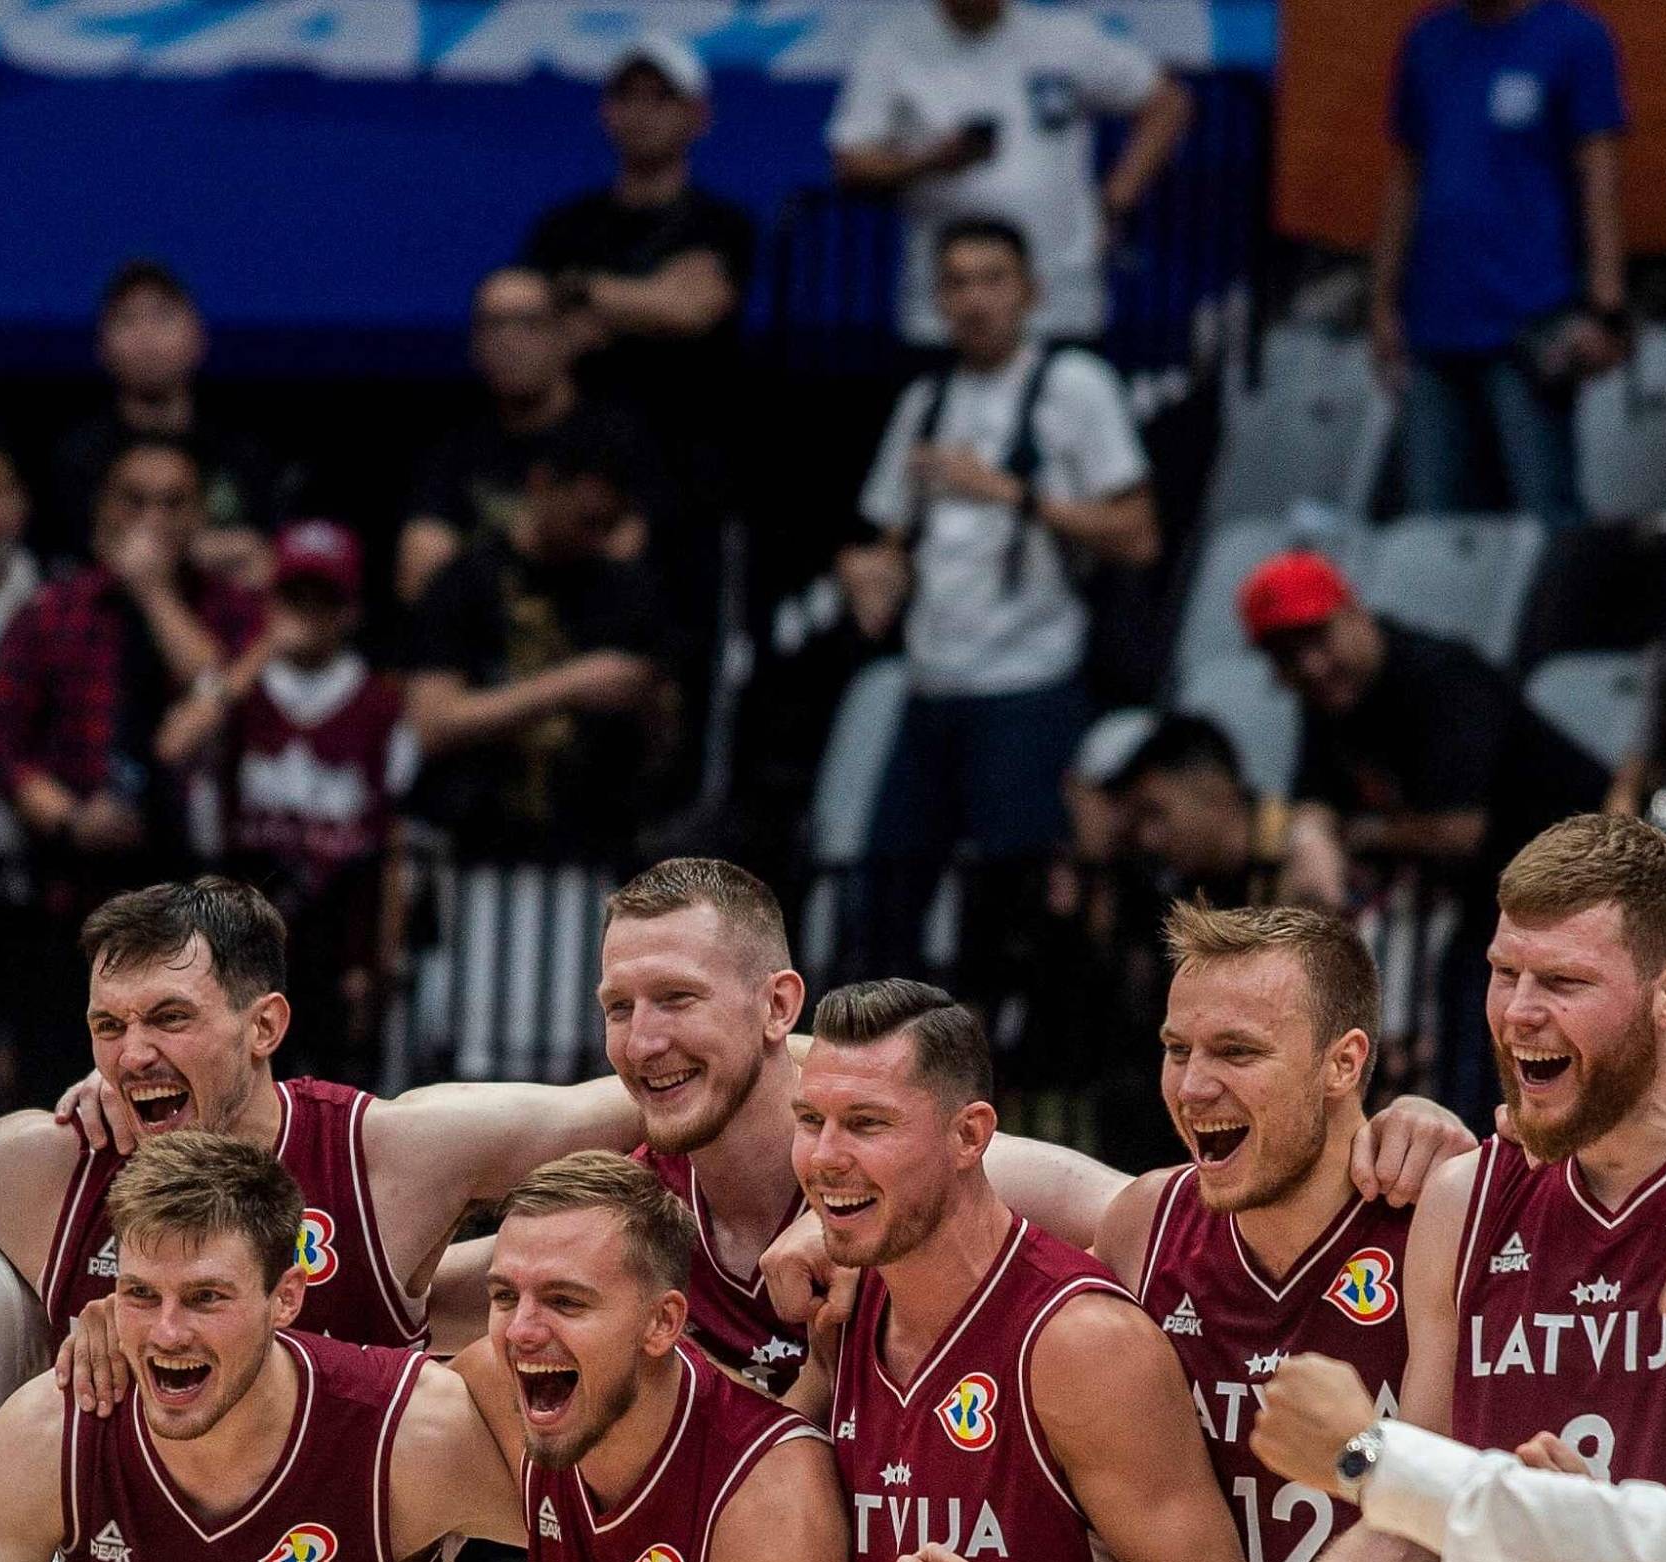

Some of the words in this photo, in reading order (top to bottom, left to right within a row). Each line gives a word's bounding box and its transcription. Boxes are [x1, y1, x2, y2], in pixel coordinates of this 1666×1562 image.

[87, 1257, 120, 1277] PEA
[1489, 1253, 1531, 1273] PEAK
[1163, 1314, 1204, 1337] PEAK
[539, 1520, 563, 1543] EAK
[854, 1492, 1009, 1558] TVIJA
